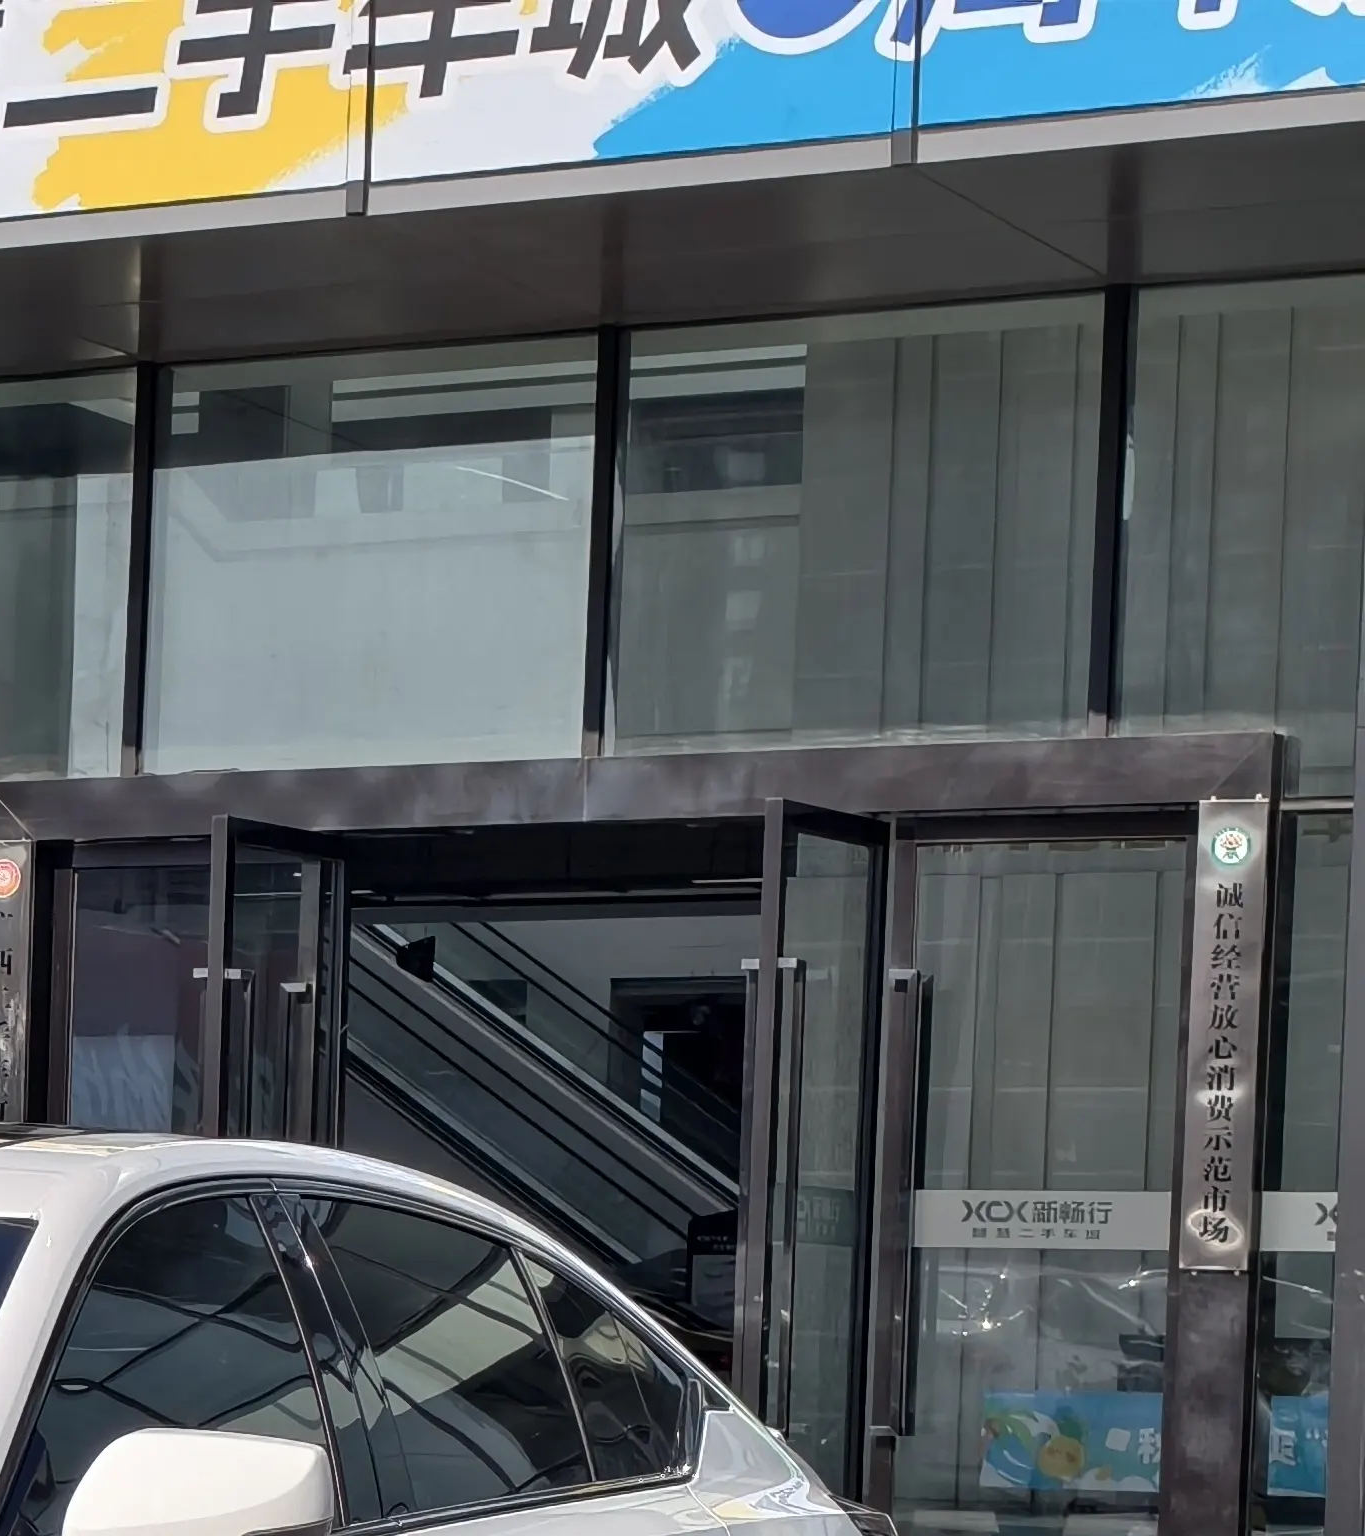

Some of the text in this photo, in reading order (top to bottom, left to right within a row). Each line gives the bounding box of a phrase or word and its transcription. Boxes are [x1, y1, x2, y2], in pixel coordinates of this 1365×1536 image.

[1198, 882, 1244, 1243] 诚信经营放心消费示范市场
[1032, 1200, 1113, 1224] 新畅行
